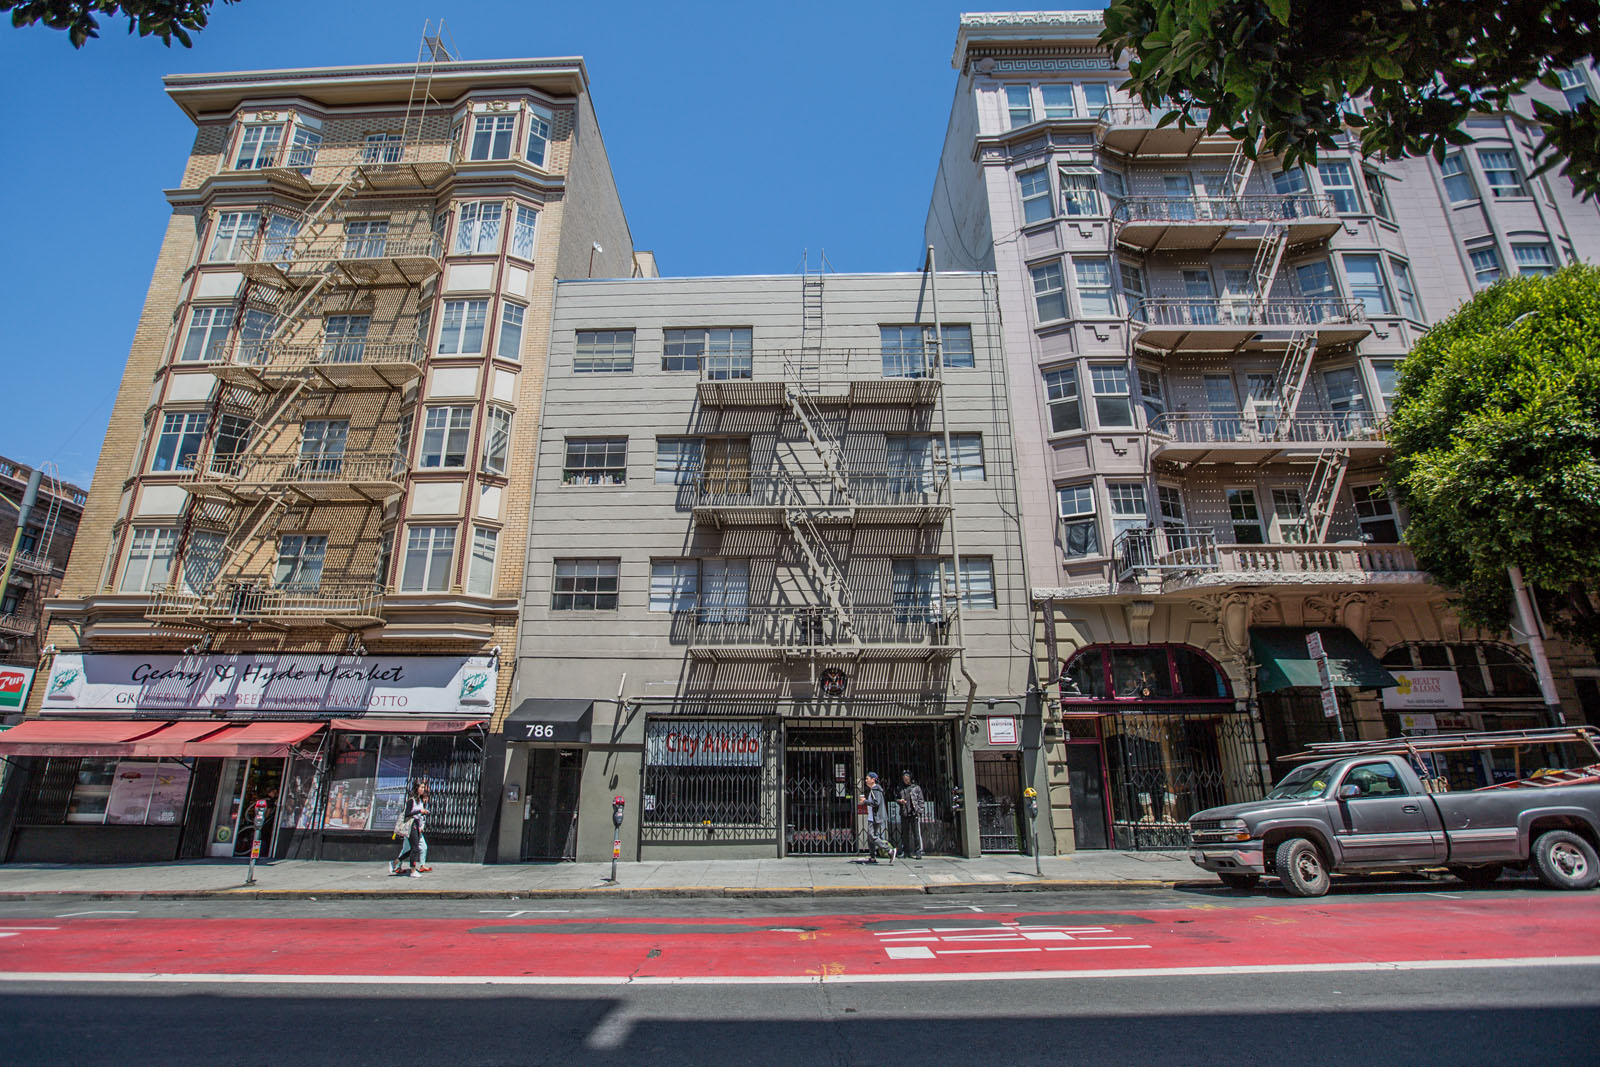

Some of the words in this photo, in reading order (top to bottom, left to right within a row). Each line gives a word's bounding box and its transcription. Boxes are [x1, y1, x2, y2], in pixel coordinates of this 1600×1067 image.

[132, 664, 204, 688] Geary
[214, 664, 233, 682] &
[243, 663, 308, 688] Hyde
[314, 663, 405, 682] Market
[1412, 678, 1440, 686] REALTY
[237, 693, 265, 705] BEER
[362, 695, 408, 707] LOTTO
[526, 724, 553, 737] 786
[666, 732, 699, 758] City
[702, 732, 759, 753] Aikido
